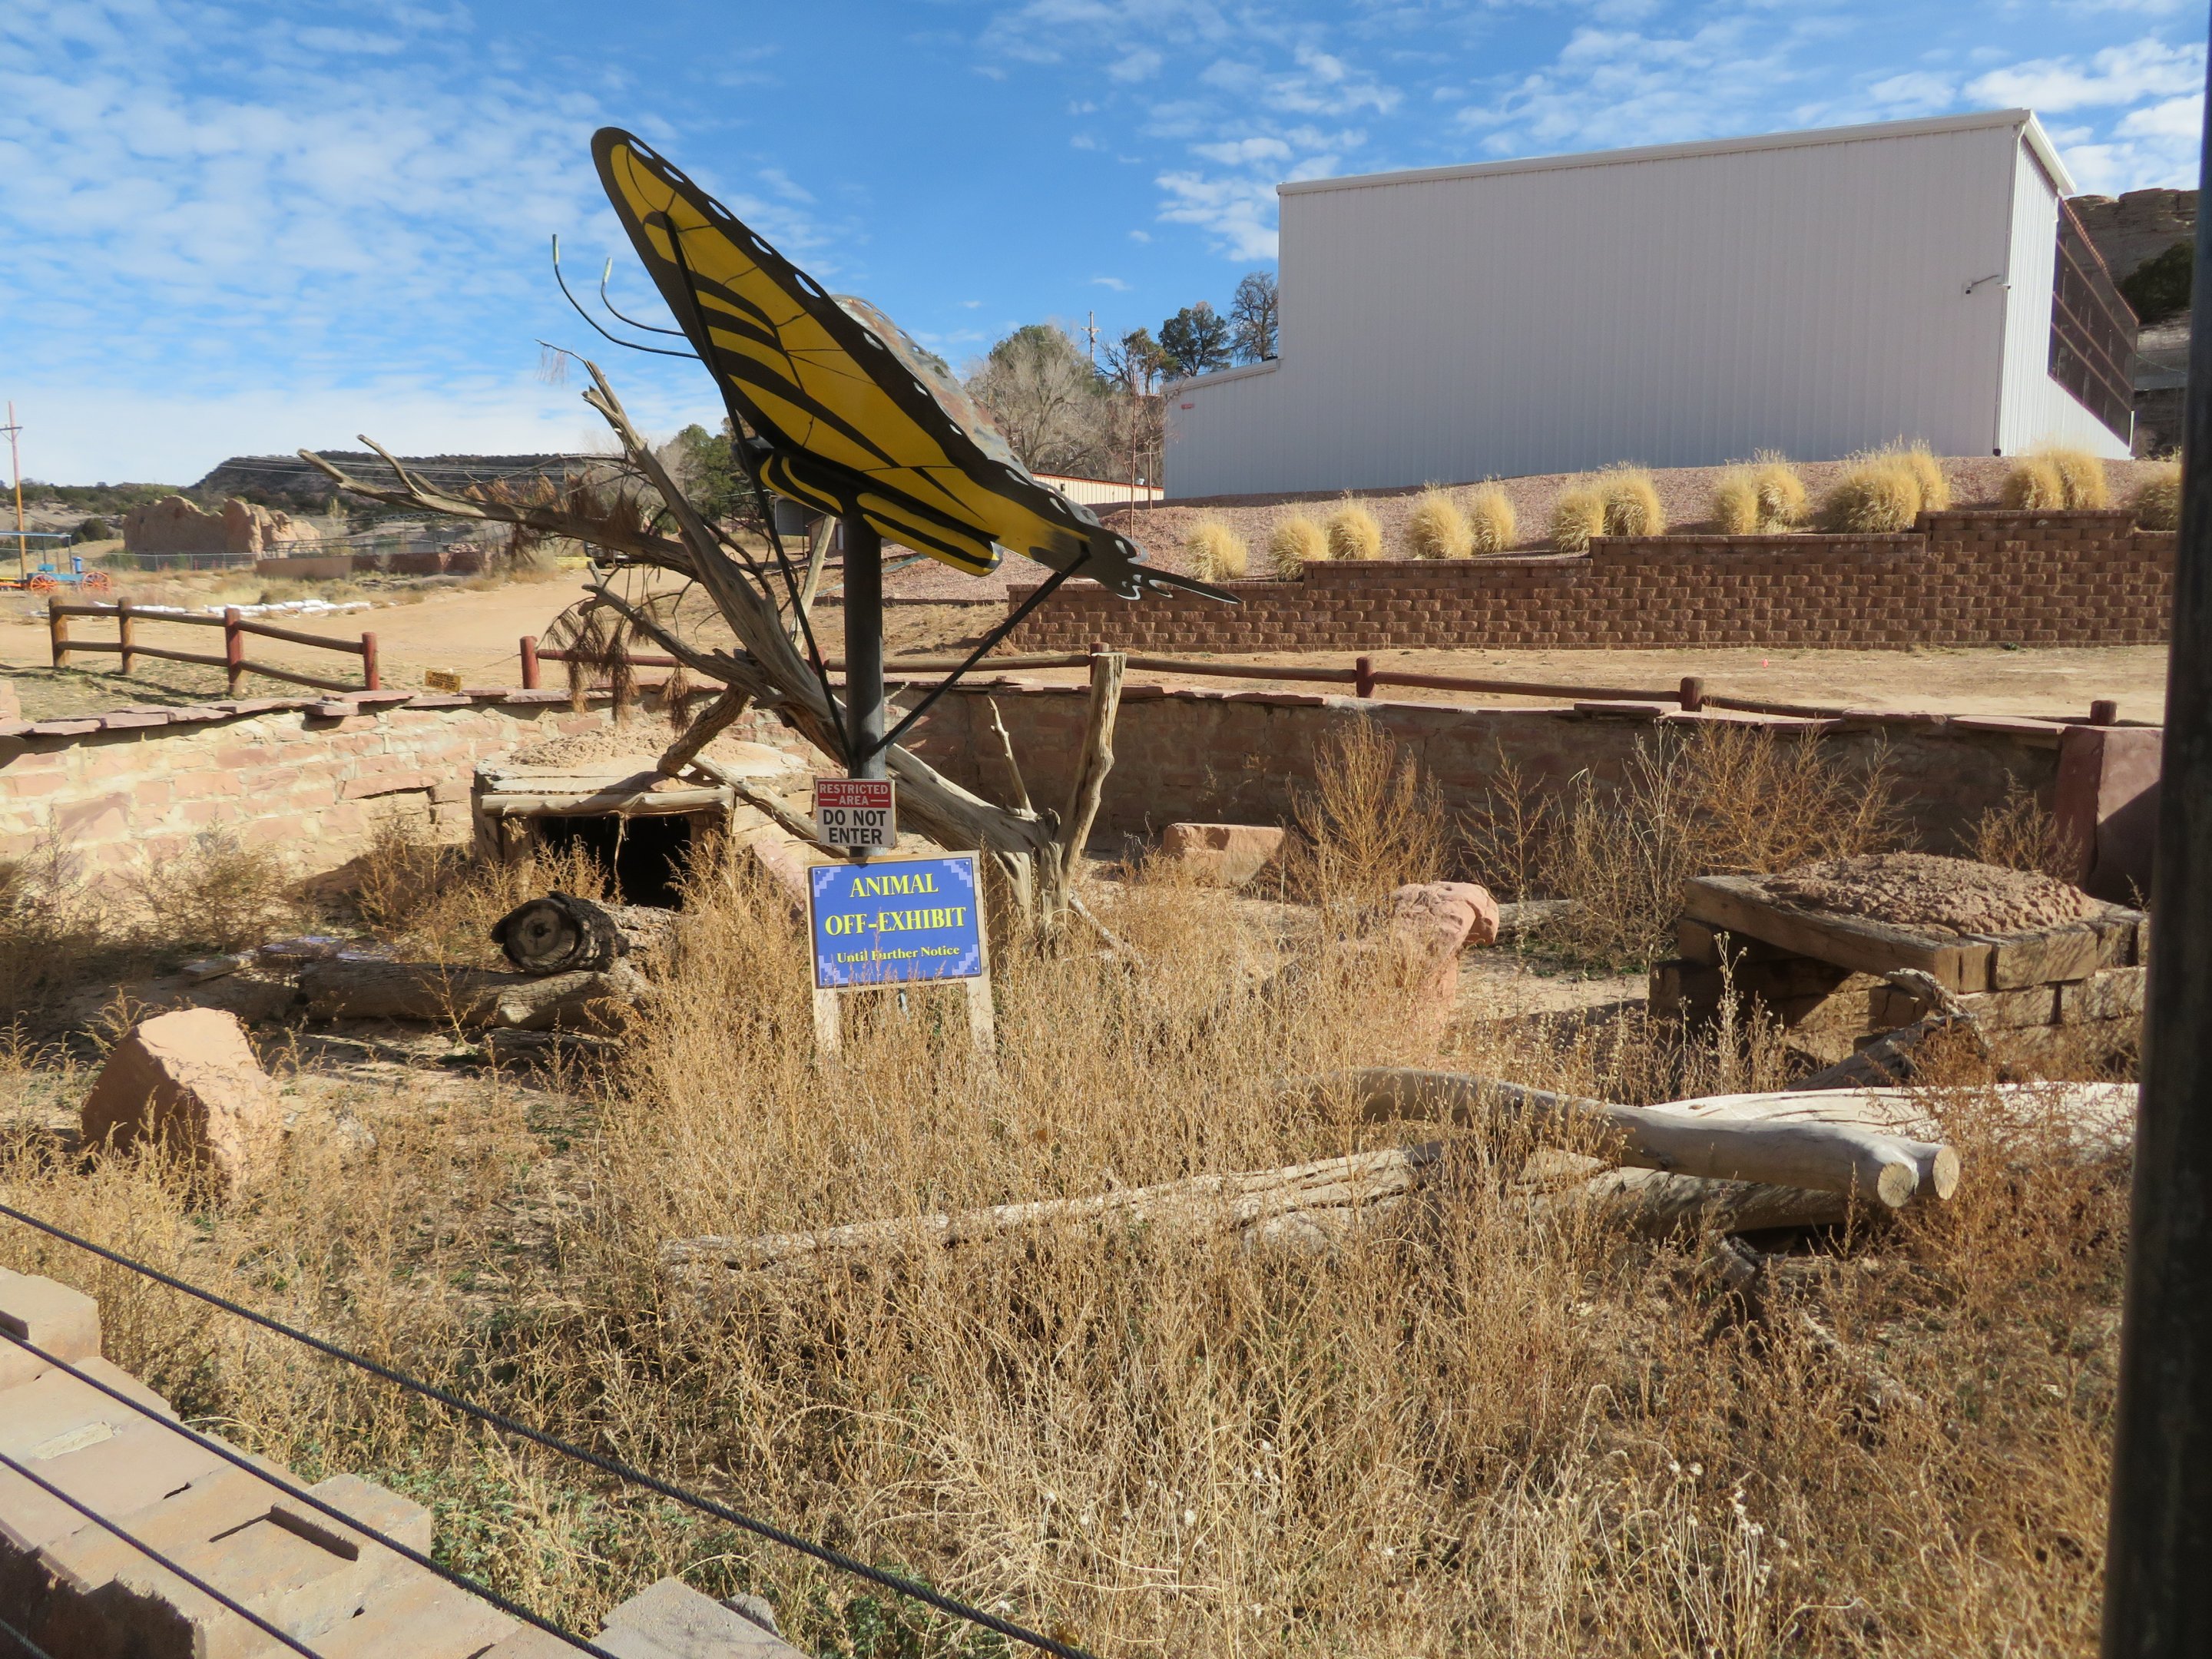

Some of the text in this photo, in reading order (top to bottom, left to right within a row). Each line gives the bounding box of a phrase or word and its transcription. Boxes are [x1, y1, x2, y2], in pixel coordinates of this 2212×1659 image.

[820, 783, 889, 794] RESTRICTED
[839, 795, 869, 806] AREA
[823, 809, 886, 826] DO NOT
[829, 827, 882, 845] ENTER
[849, 873, 939, 898] ANIMAL
[825, 907, 966, 936] OFF-EXHIBIT
[837, 949, 869, 963] Until
[920, 945, 960, 957] Notice
